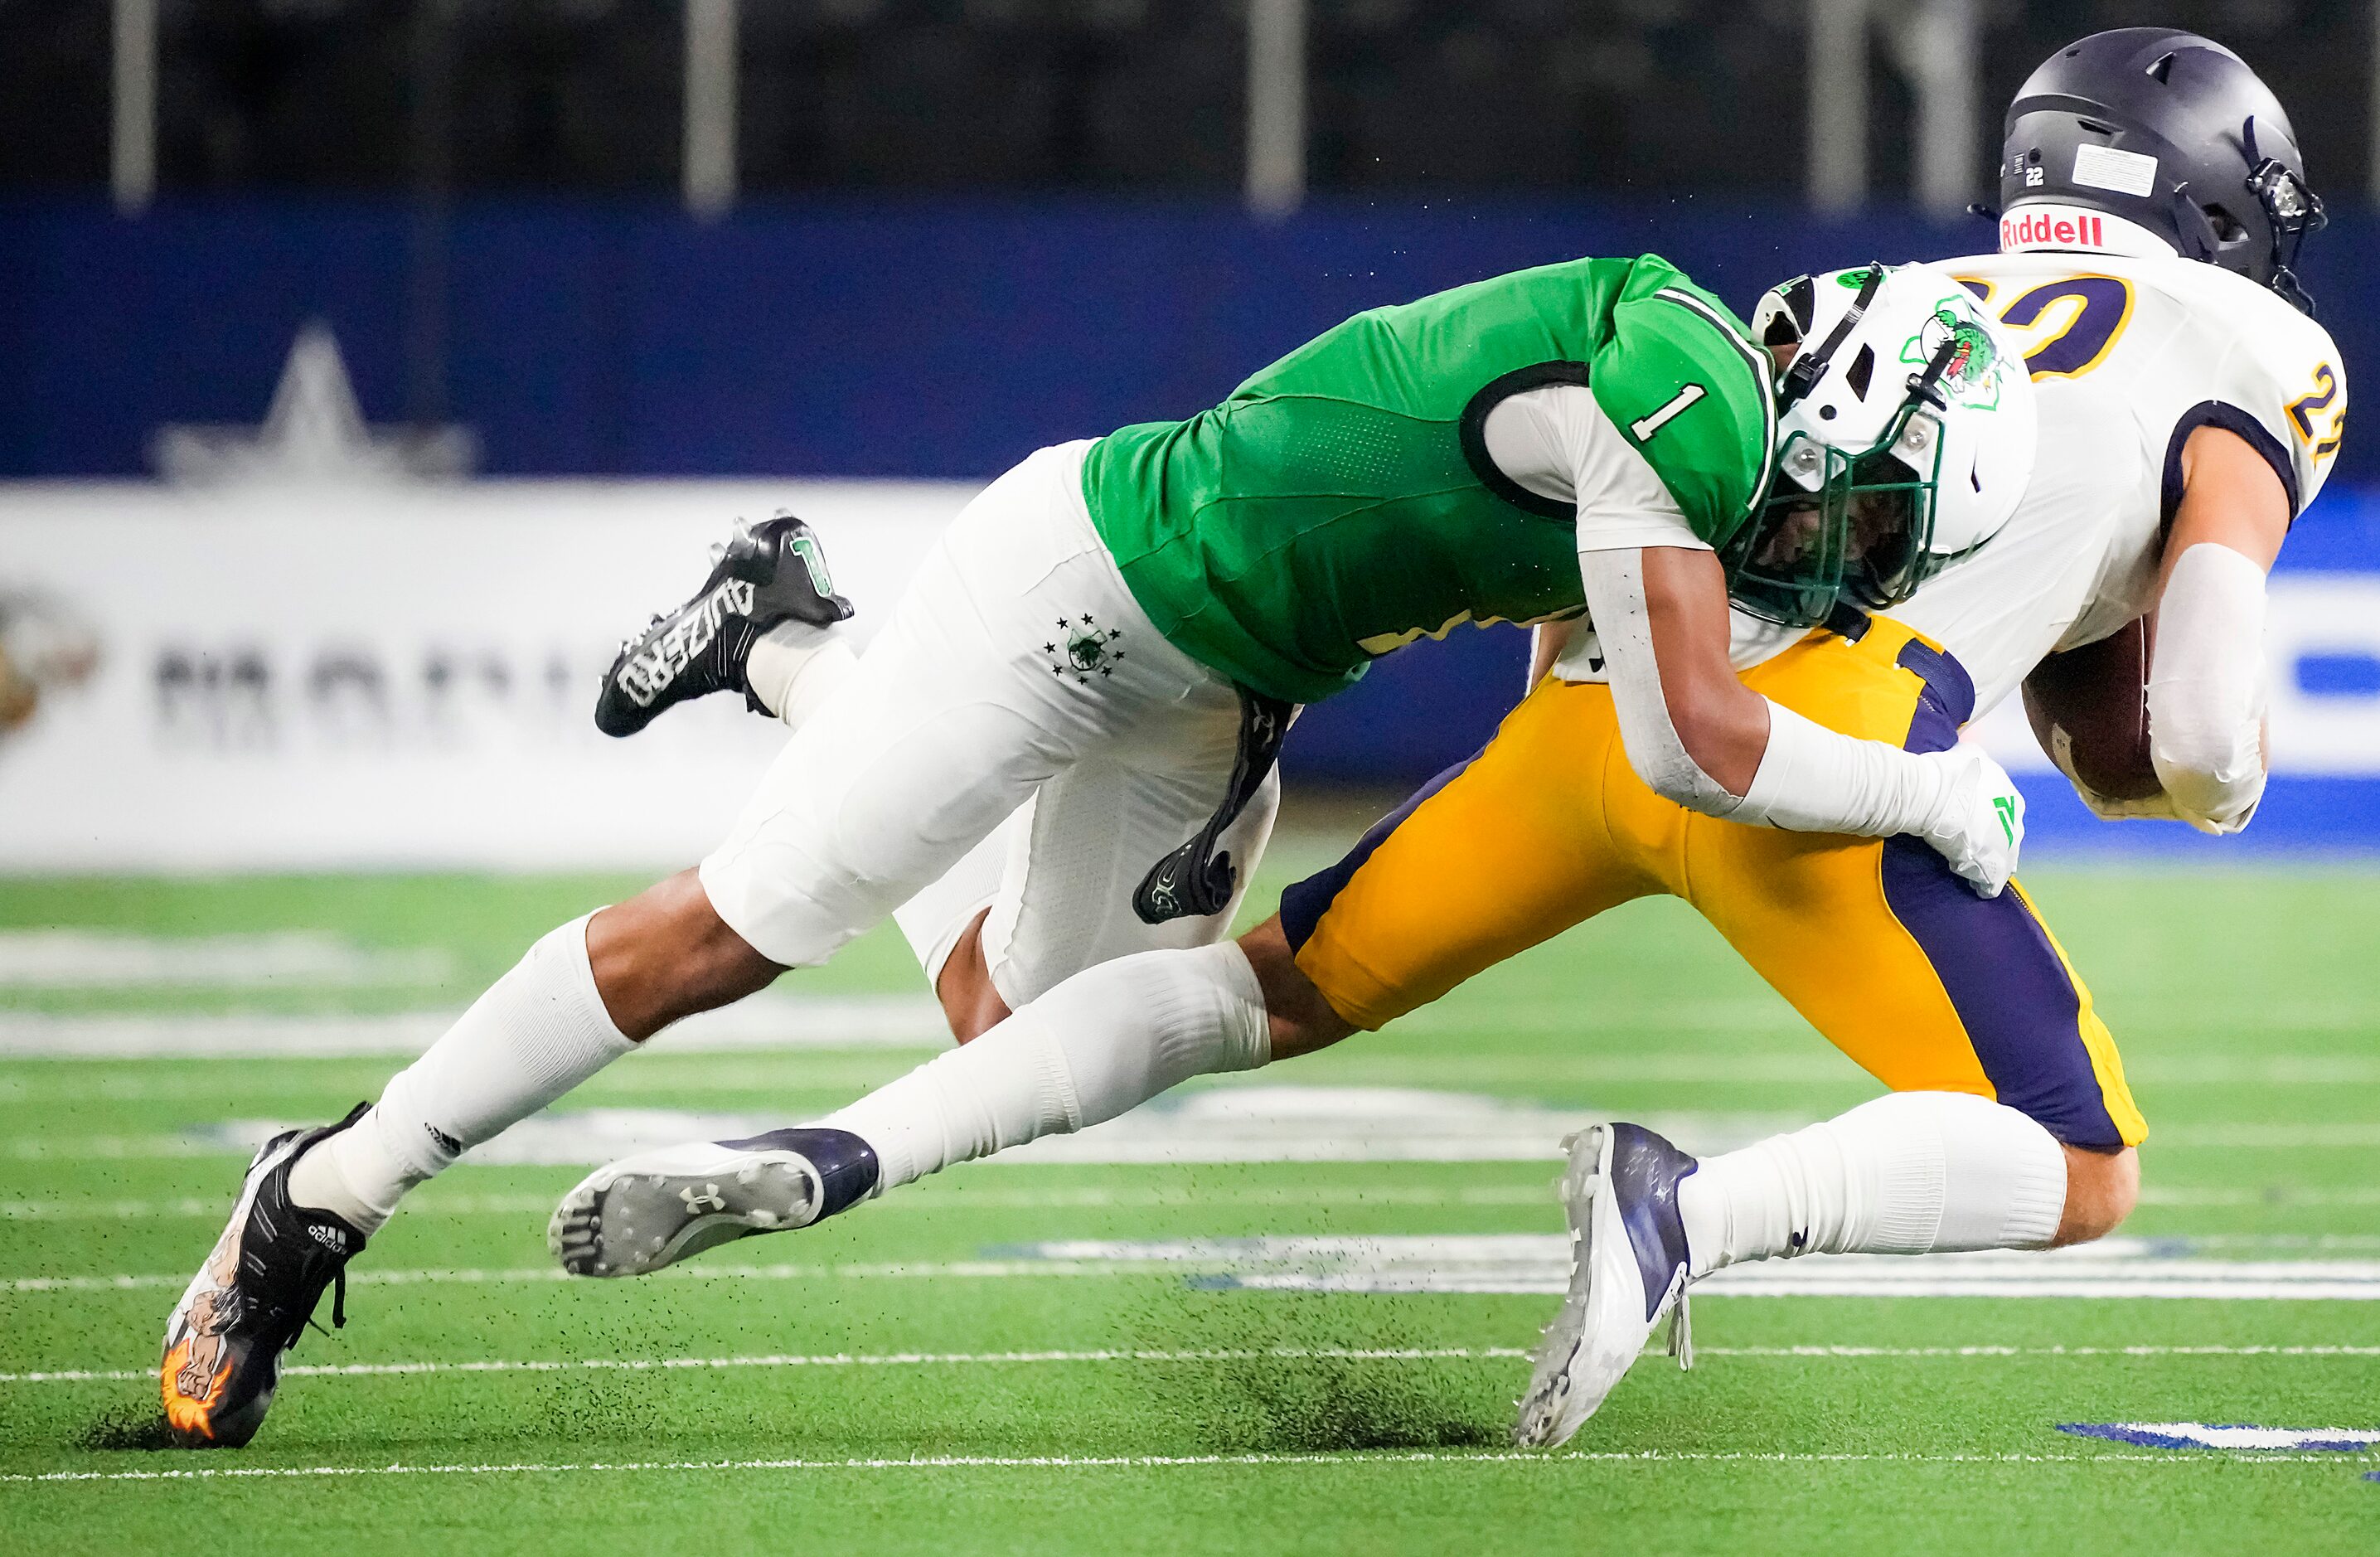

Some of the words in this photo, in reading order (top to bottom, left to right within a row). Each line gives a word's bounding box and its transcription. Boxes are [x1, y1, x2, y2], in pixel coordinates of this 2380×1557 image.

[2025, 167, 2044, 187] 22
[2002, 213, 2103, 250] Riddell
[1628, 382, 1709, 444] 1
